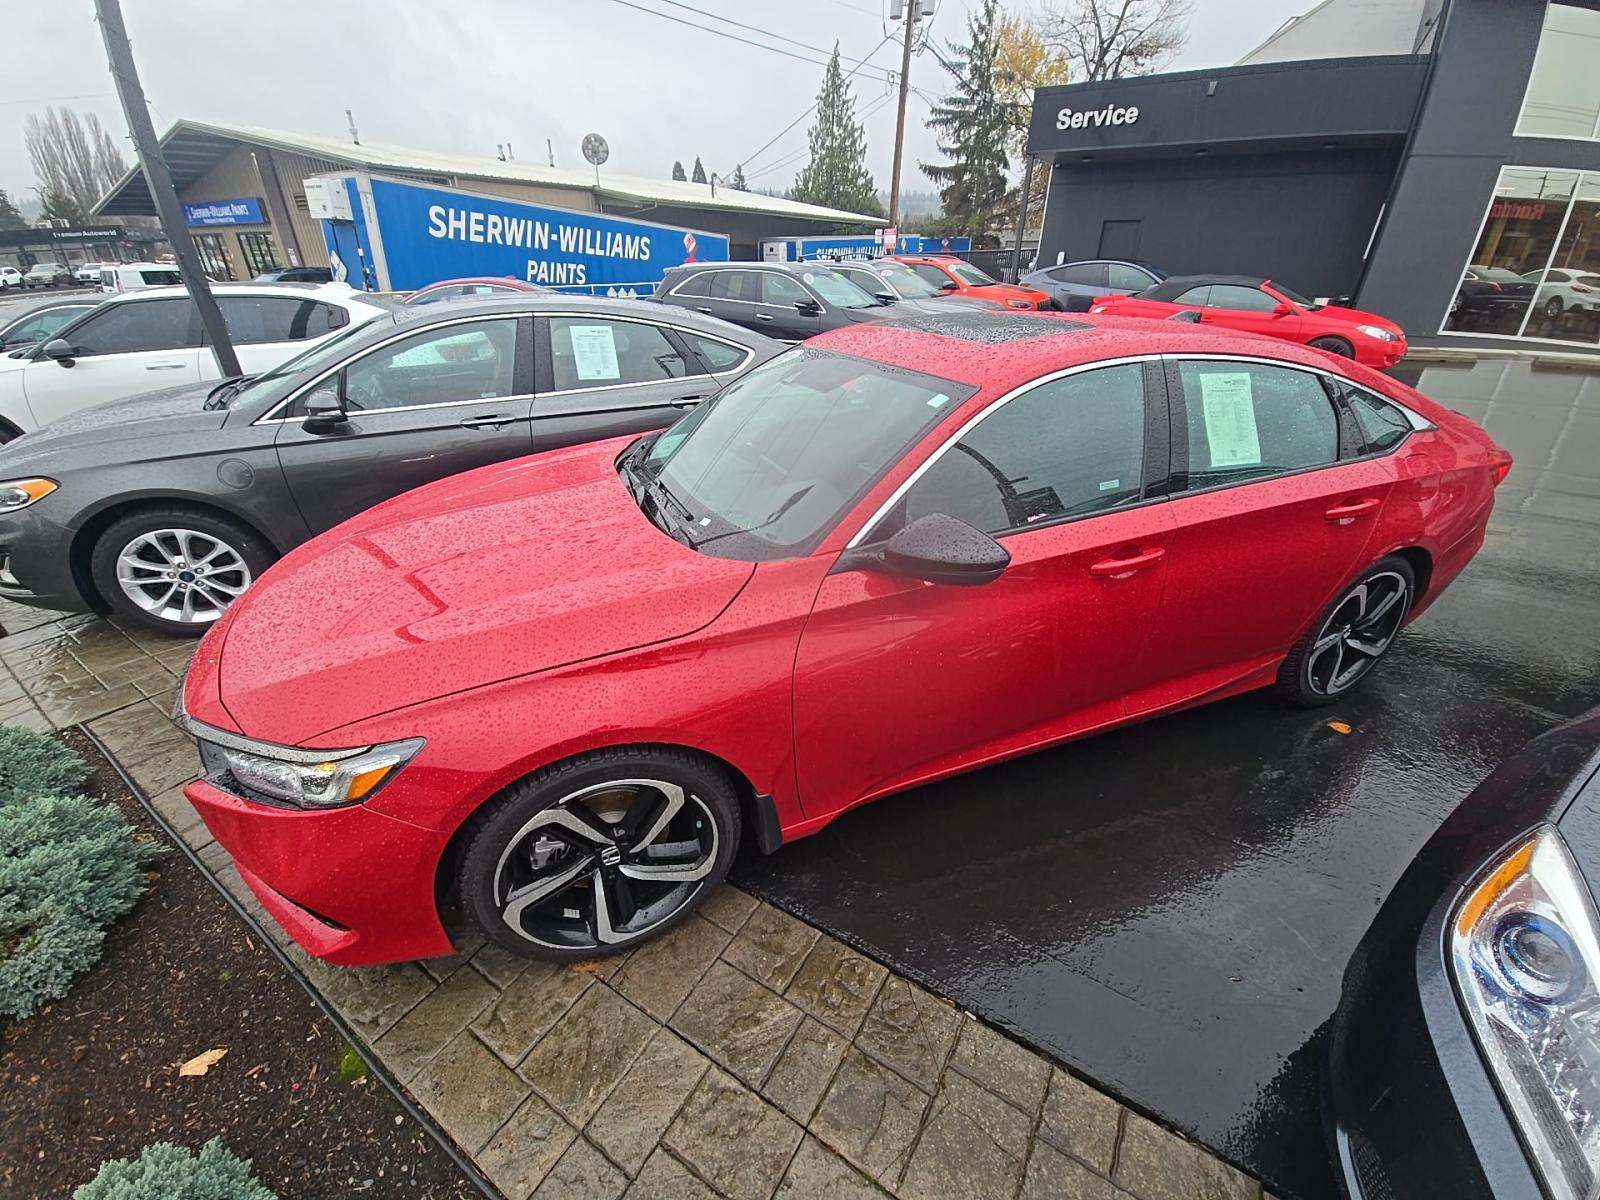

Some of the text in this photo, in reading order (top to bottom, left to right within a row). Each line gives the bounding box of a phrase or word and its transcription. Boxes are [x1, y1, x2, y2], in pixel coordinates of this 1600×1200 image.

[1056, 104, 1139, 129] Service
[428, 205, 650, 261] SHERWIN-WILLIAMS
[527, 259, 586, 285] PAINTS
